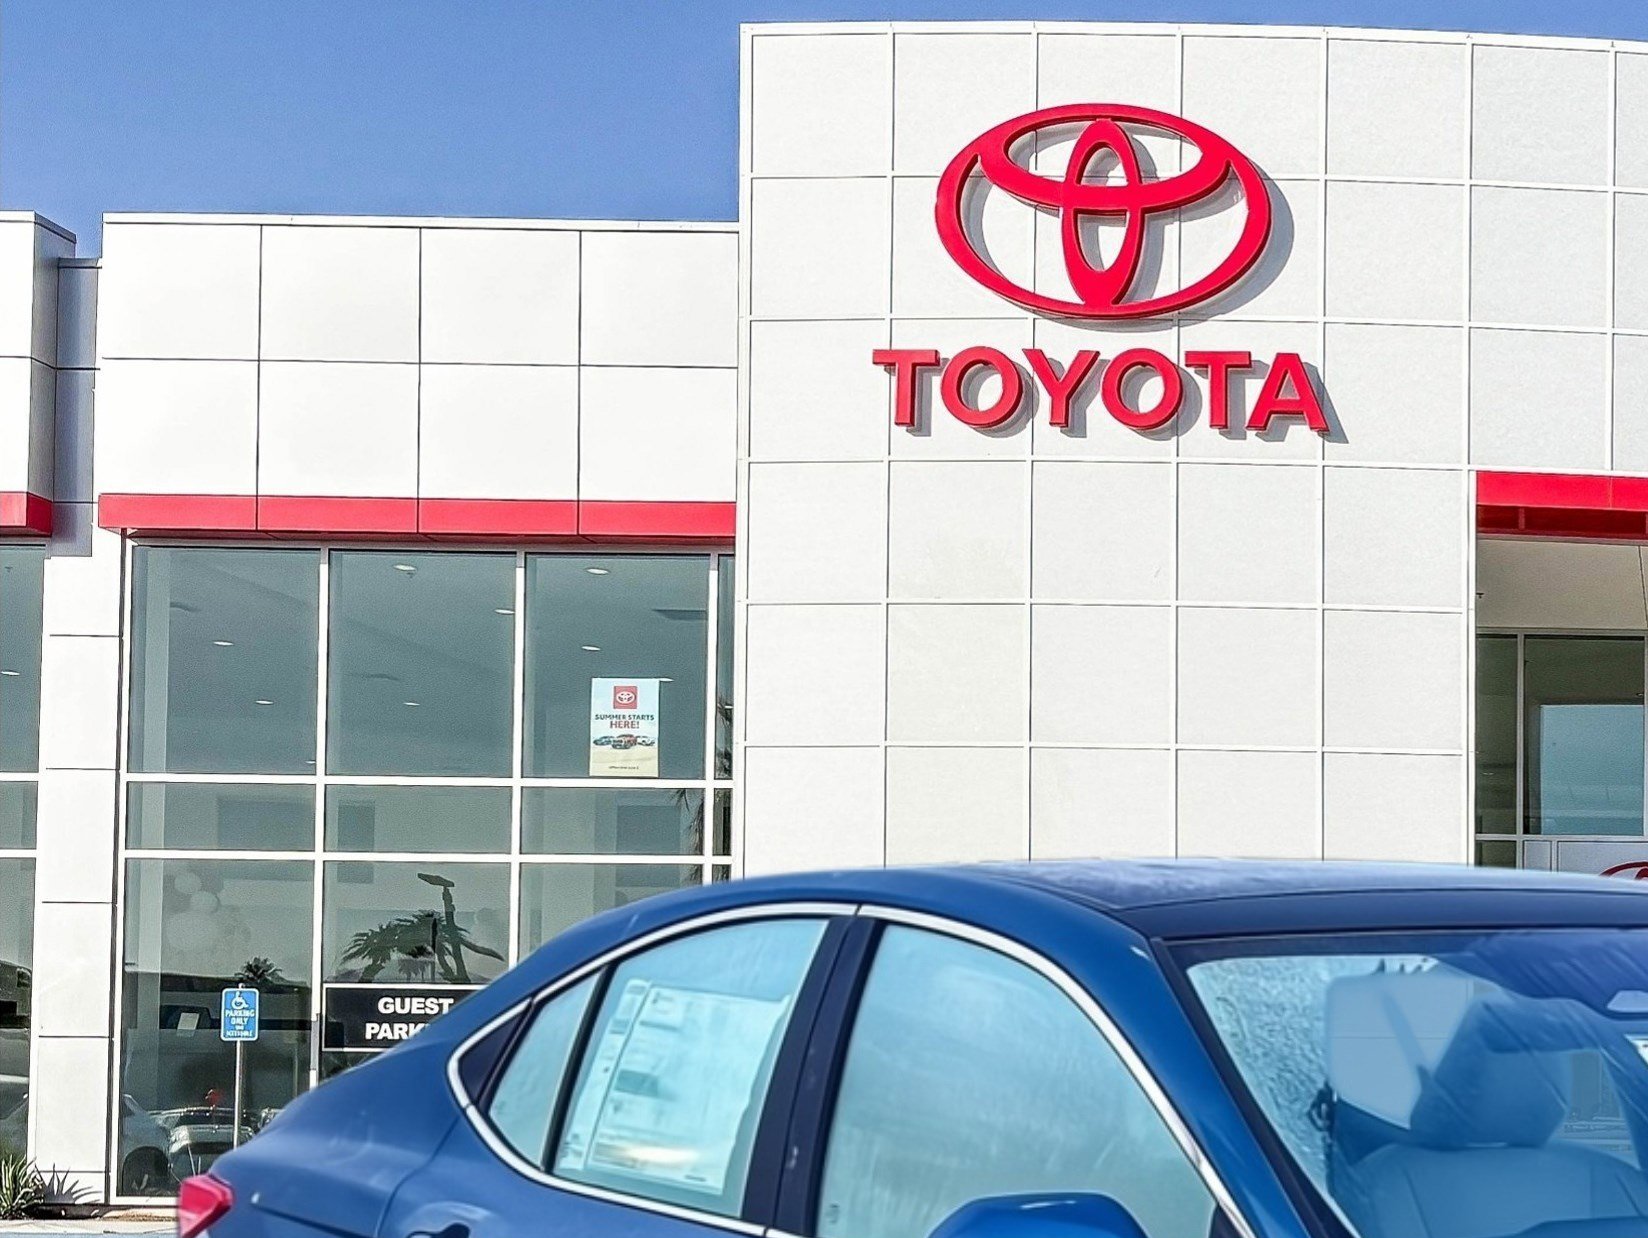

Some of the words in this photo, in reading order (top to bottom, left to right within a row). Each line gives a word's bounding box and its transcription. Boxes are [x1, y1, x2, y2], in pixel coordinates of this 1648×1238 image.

[872, 345, 1331, 433] TOYOTA
[610, 721, 640, 729] HERE!
[225, 1009, 255, 1017] PARKING
[377, 997, 454, 1015] GUEST
[365, 1022, 428, 1040] PARK
